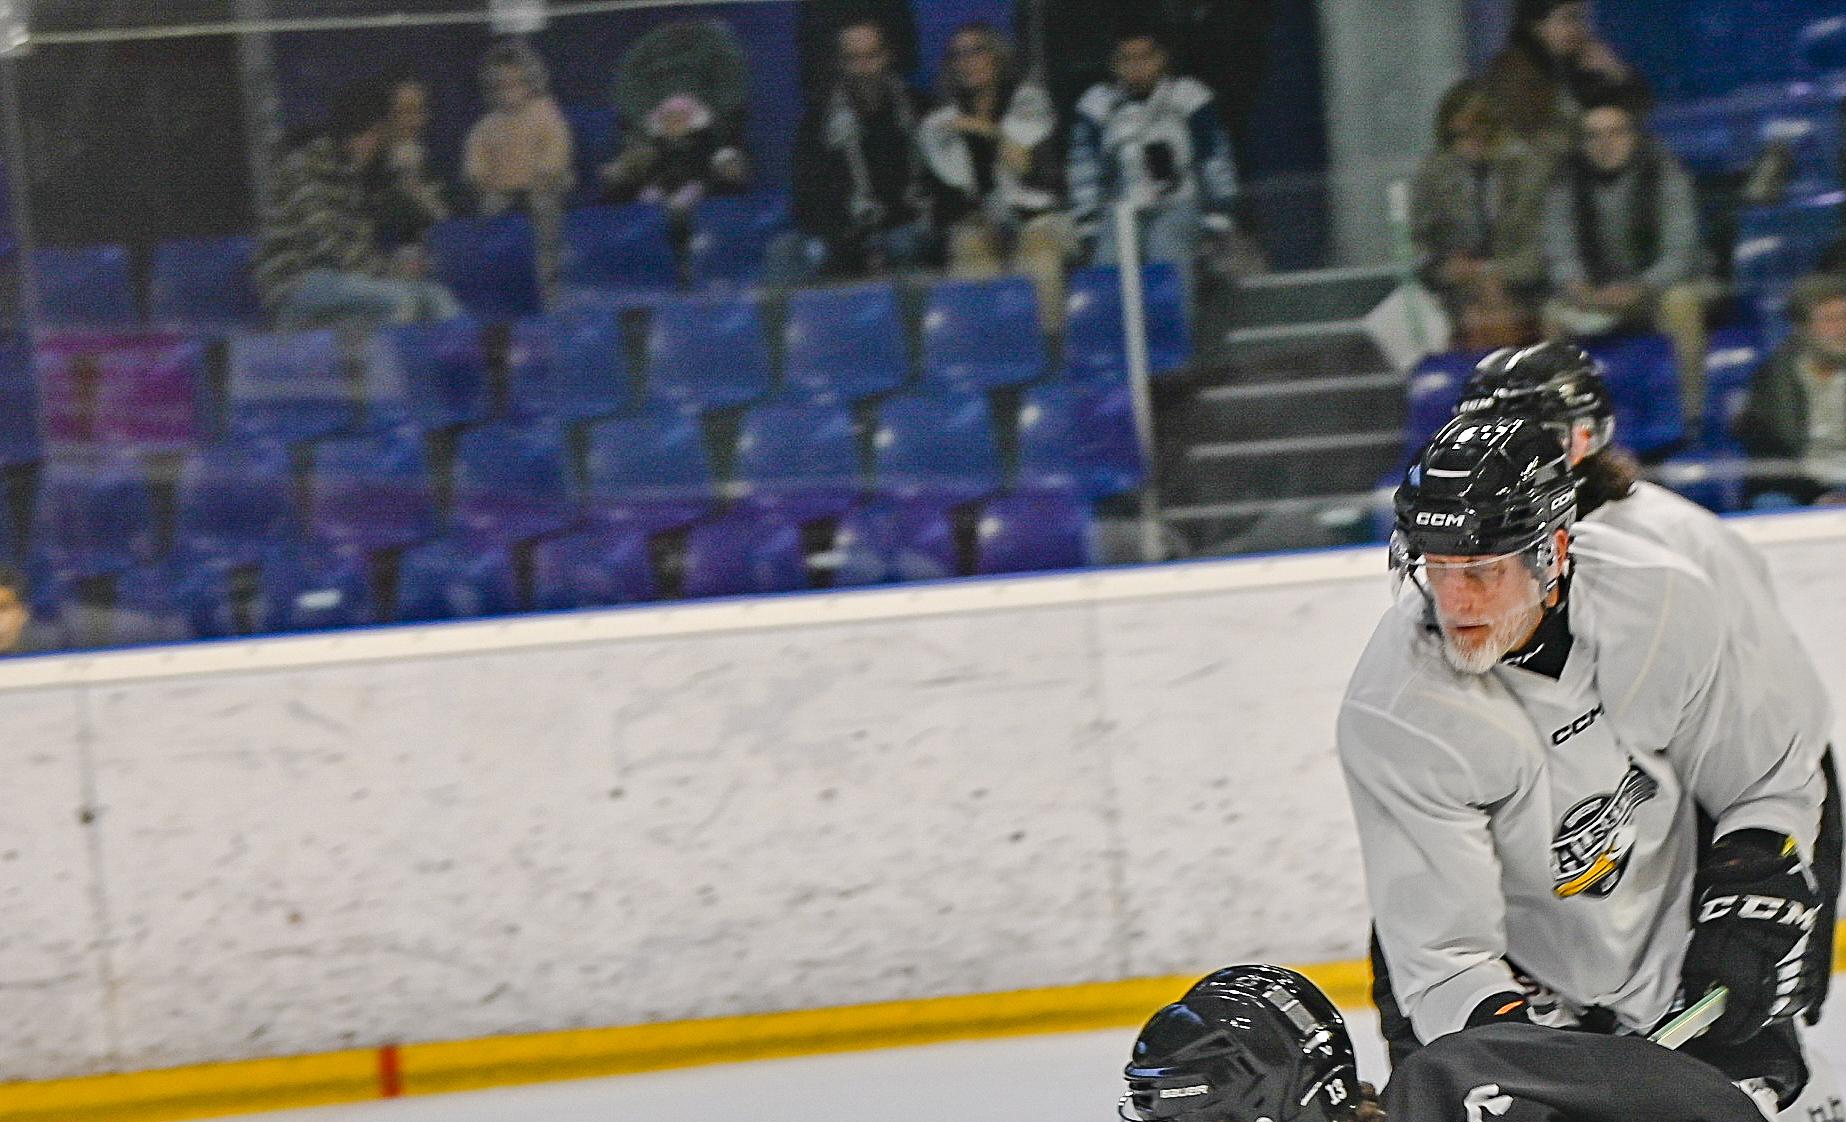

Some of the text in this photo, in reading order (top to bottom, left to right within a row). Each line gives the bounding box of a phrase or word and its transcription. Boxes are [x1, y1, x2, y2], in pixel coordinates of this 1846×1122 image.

[1416, 511, 1466, 527] CCM
[1697, 894, 1823, 931] CCM
[1324, 1078, 1348, 1106] 13
